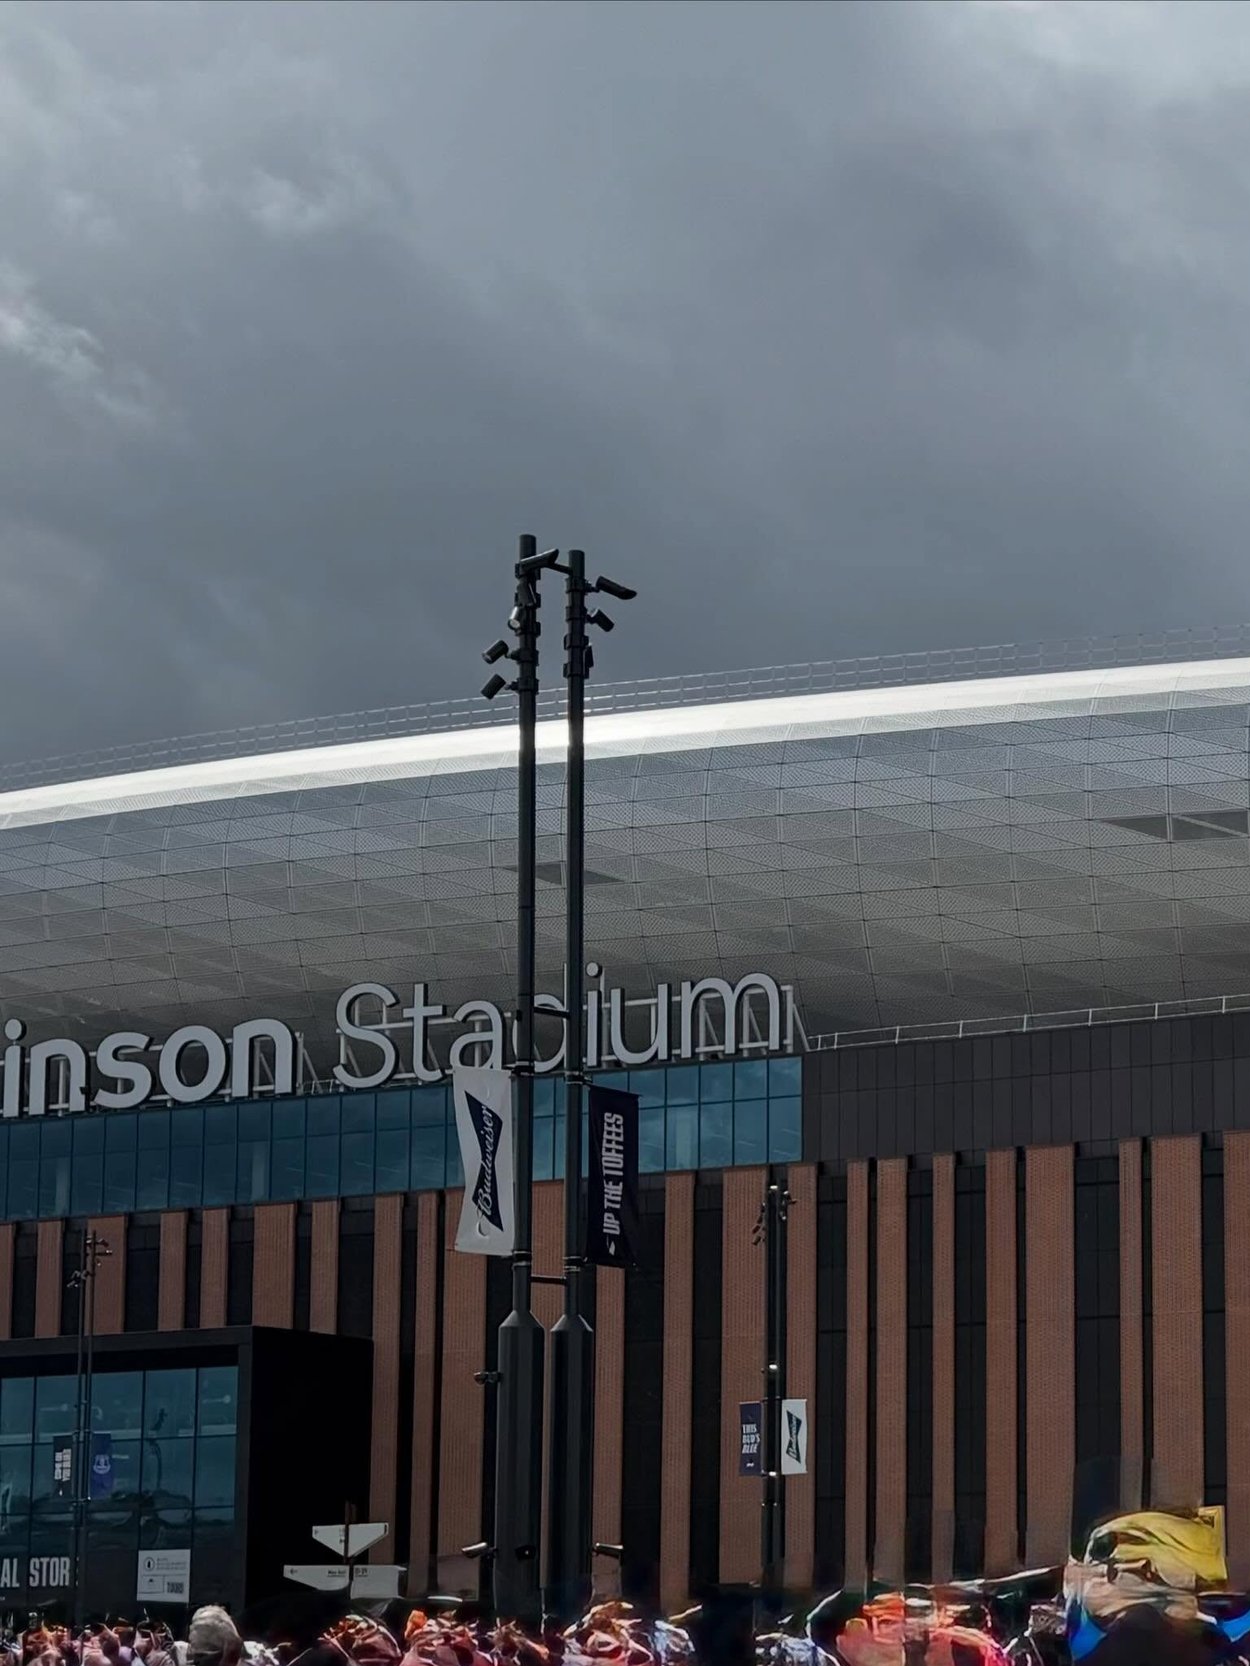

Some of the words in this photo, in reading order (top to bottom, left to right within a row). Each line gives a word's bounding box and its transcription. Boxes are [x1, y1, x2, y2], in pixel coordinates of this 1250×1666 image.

[3, 1019, 294, 1117] inson
[332, 961, 781, 1088] Stadium
[476, 1104, 494, 1219] Budweiser
[602, 1112, 624, 1177] TOFFEES
[602, 1179, 623, 1210] THE
[603, 1213, 621, 1235] UP
